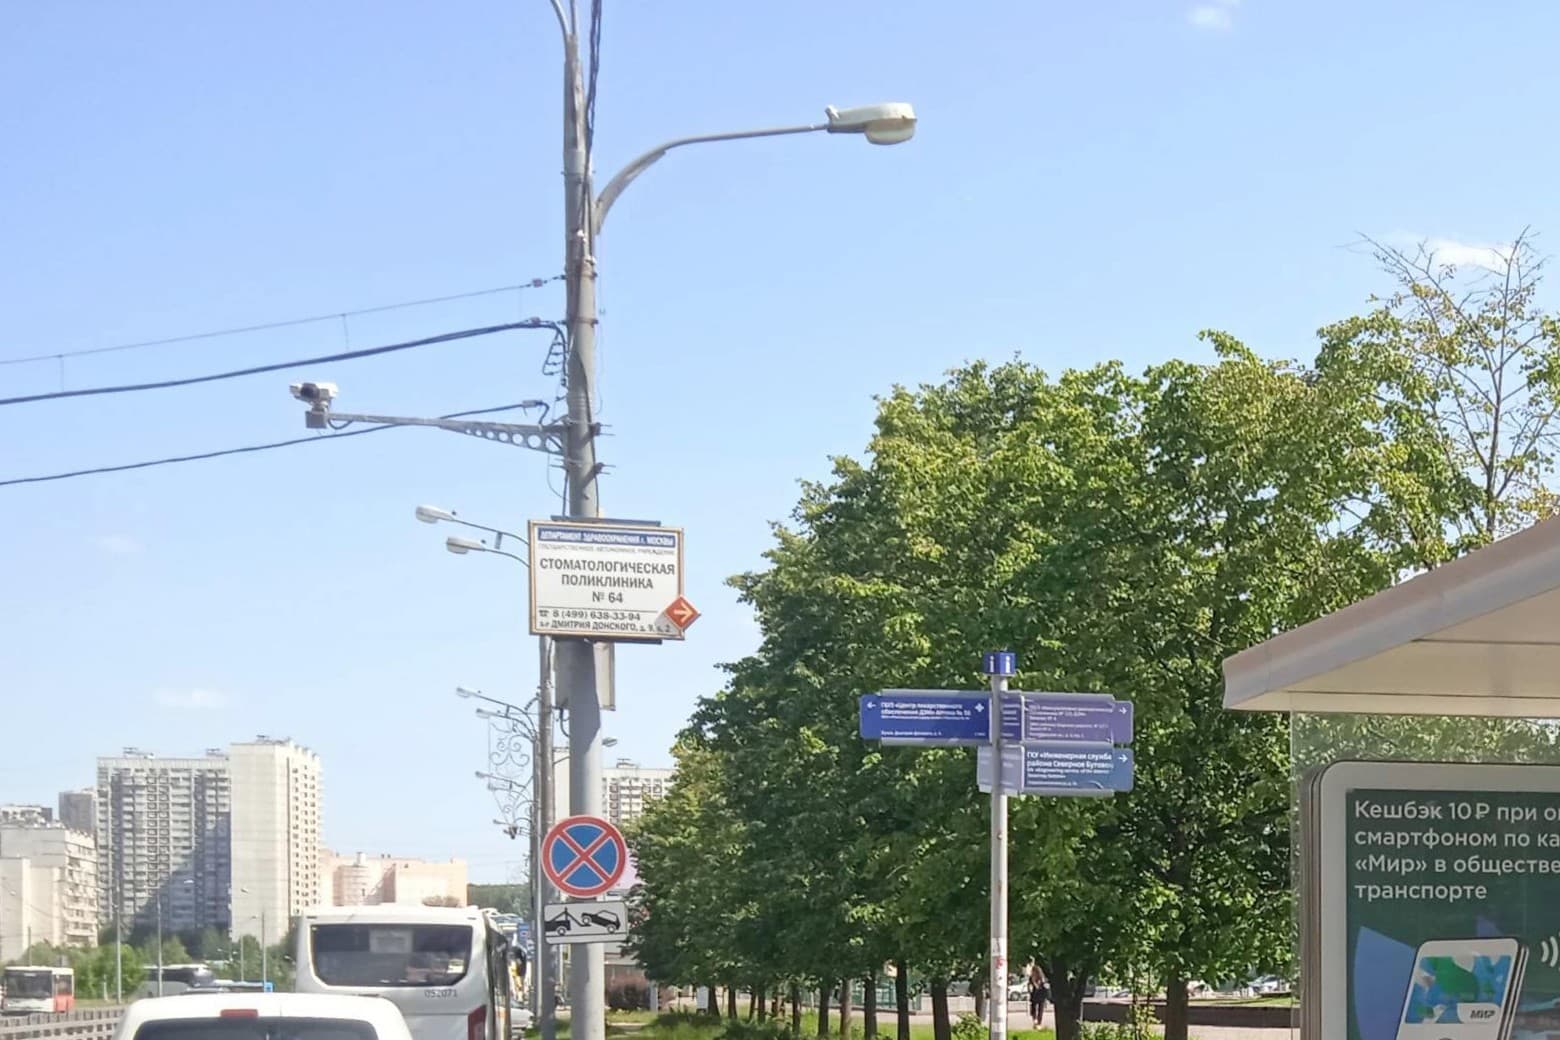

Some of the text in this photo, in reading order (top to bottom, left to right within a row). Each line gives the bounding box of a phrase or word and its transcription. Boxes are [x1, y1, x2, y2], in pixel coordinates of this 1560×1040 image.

[540, 557, 675, 575] СТОМАТОЛОГИЧЕСКАЯ
[562, 574, 654, 590] ПОЛИКЛИНИКА
[608, 592, 624, 604] 64
[561, 609, 588, 620] (499)
[551, 620, 591, 630] ДМИТРИЯ
[592, 621, 639, 632] ДОНСКОГО,
[1355, 800, 1443, 820] Кешбэк
[1497, 805, 1538, 823] при
[1354, 828, 1497, 850] смартфоном
[1504, 833, 1531, 848] по
[1355, 854, 1428, 874] «Мир»
[1435, 859, 1447, 873] в
[1355, 883, 1488, 903] транспорте
[1470, 1009, 1496, 1020] МИР
